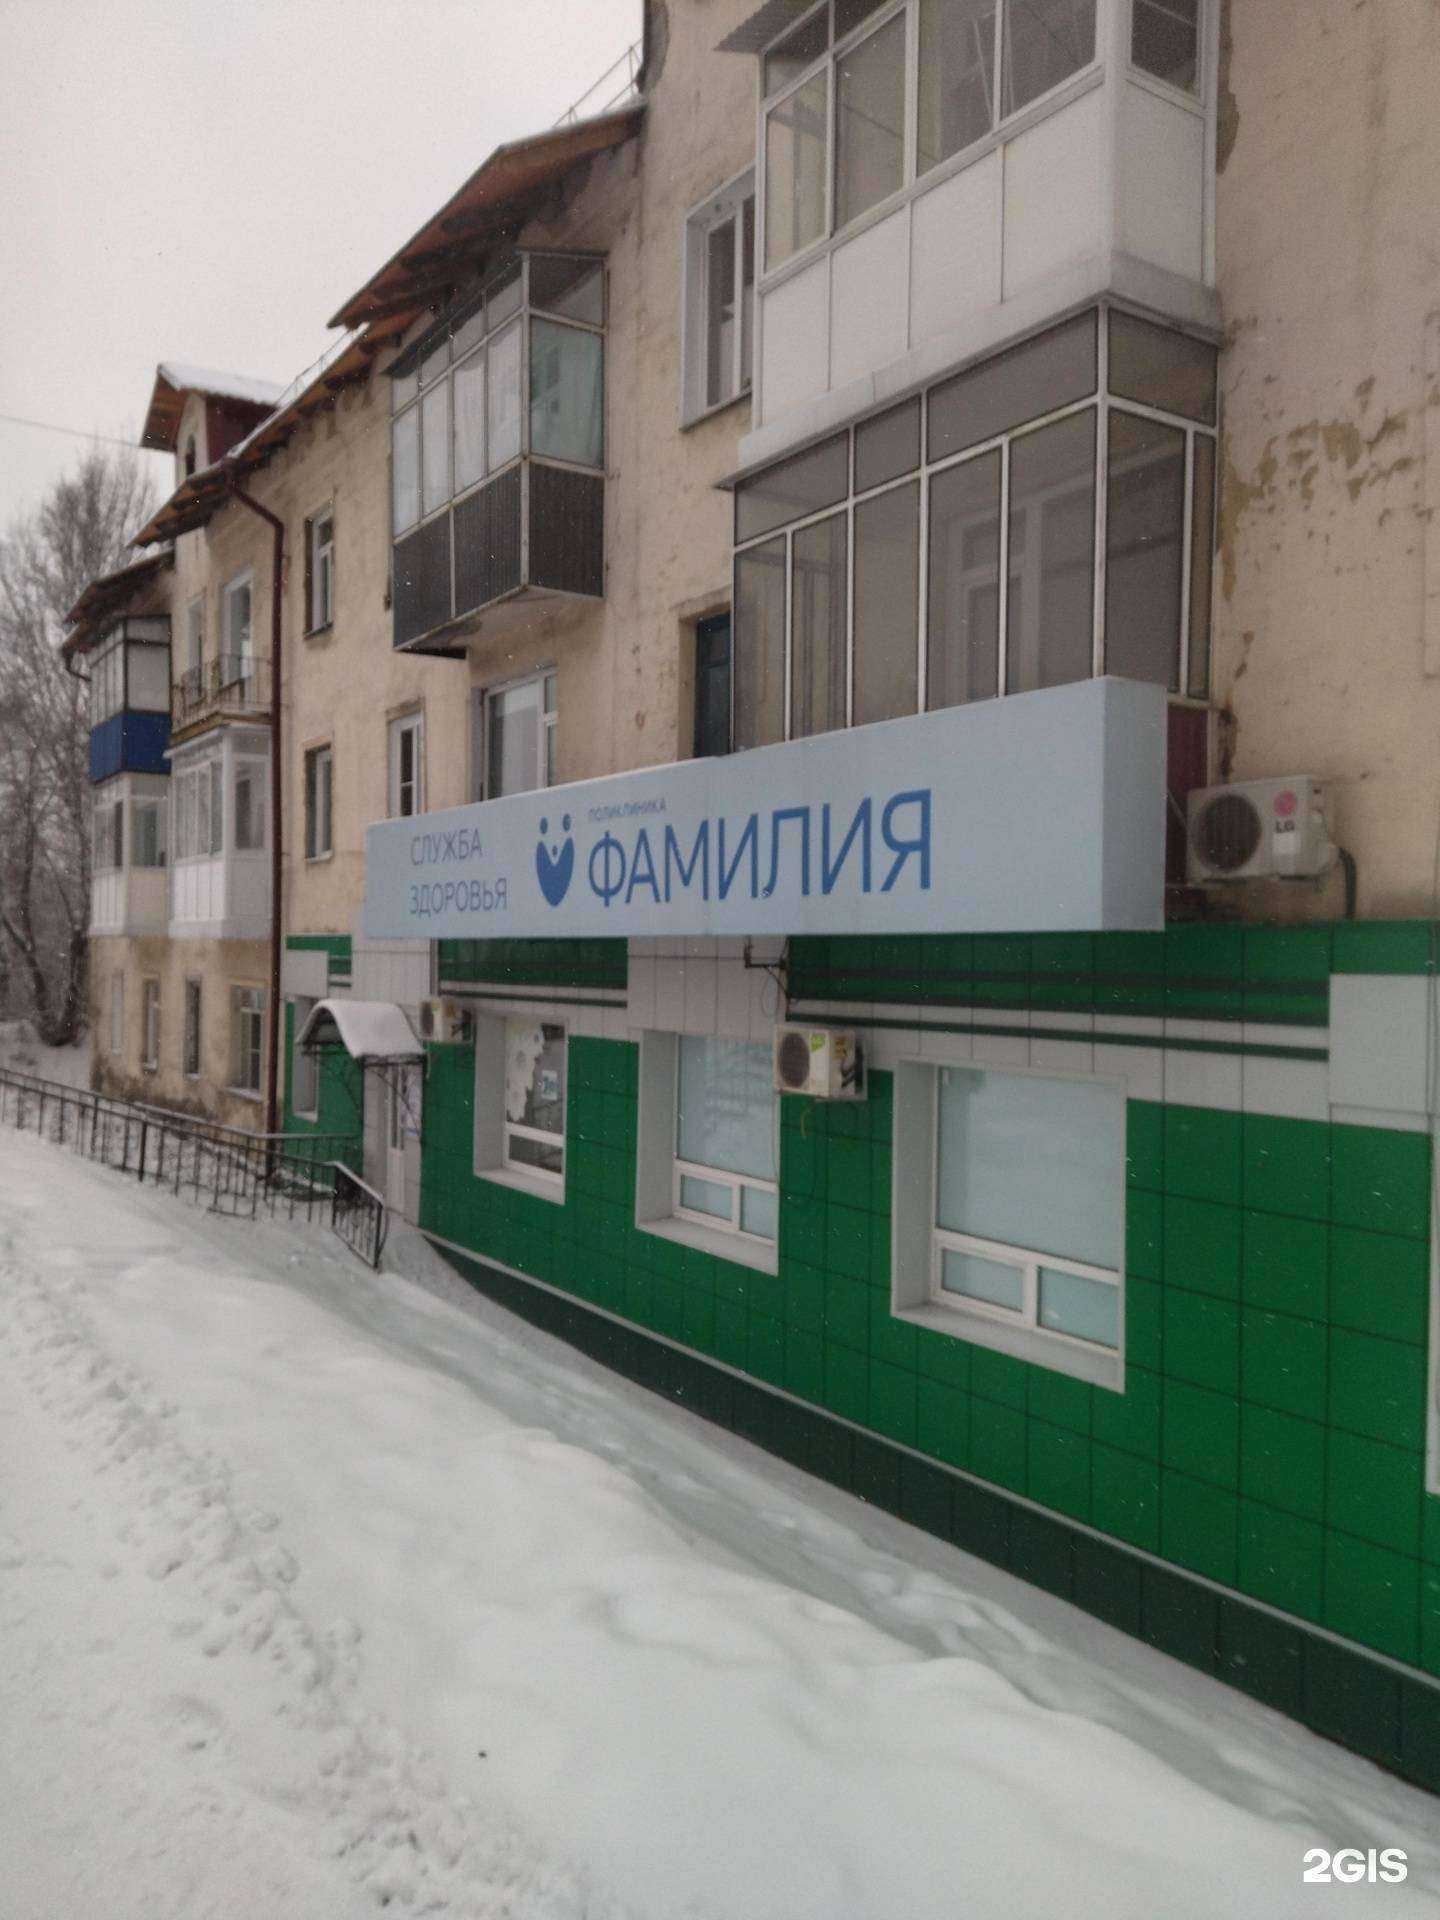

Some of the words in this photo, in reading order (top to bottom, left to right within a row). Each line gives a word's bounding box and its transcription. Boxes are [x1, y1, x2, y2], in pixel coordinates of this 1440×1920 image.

[411, 827, 483, 866] СЛУЖБА
[1275, 820, 1295, 834] LG
[588, 789, 931, 907] ФАМИЛИЯ
[409, 877, 507, 918] ЗДОРОВЬЯ
